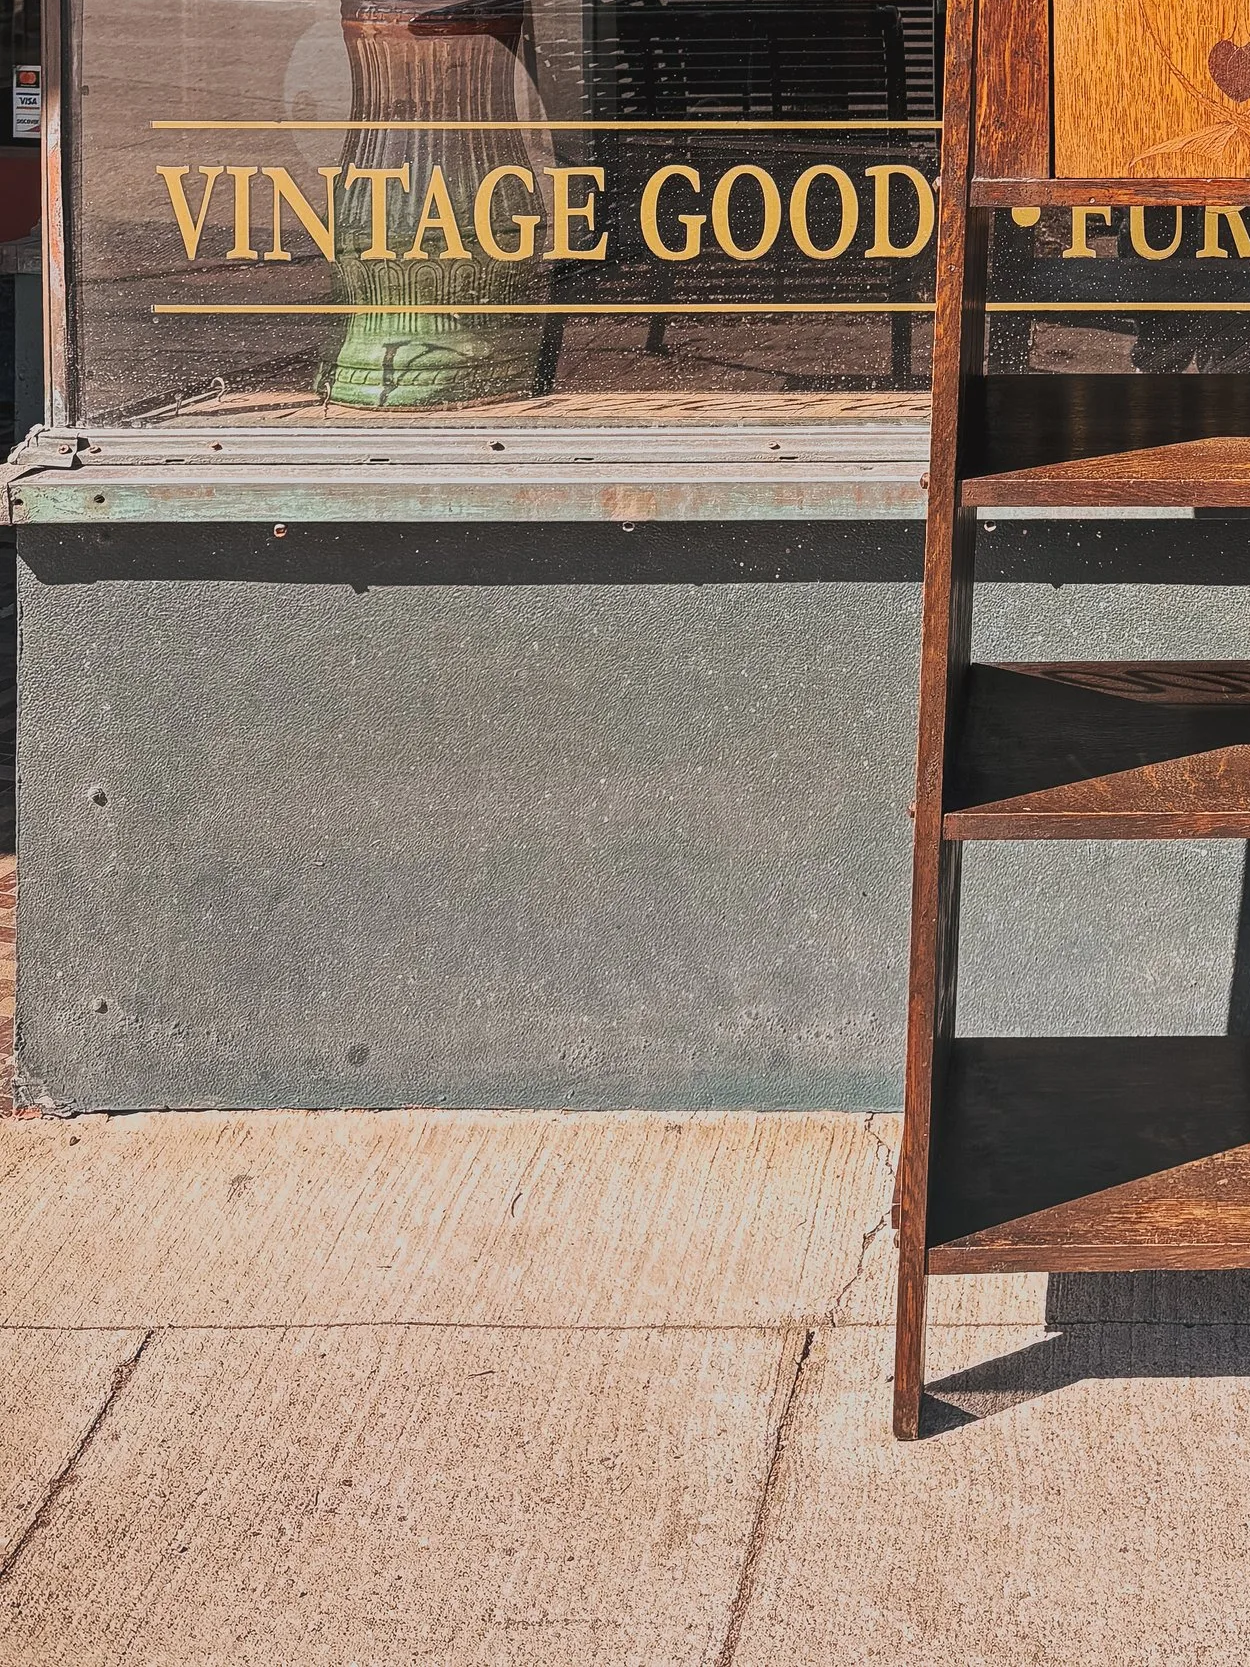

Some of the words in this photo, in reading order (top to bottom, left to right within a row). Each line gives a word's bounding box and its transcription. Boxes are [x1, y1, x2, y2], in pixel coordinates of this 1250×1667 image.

[19, 97, 37, 105] VISA
[156, 164, 608, 262] VINTAGE
[640, 164, 935, 261] GOOD
